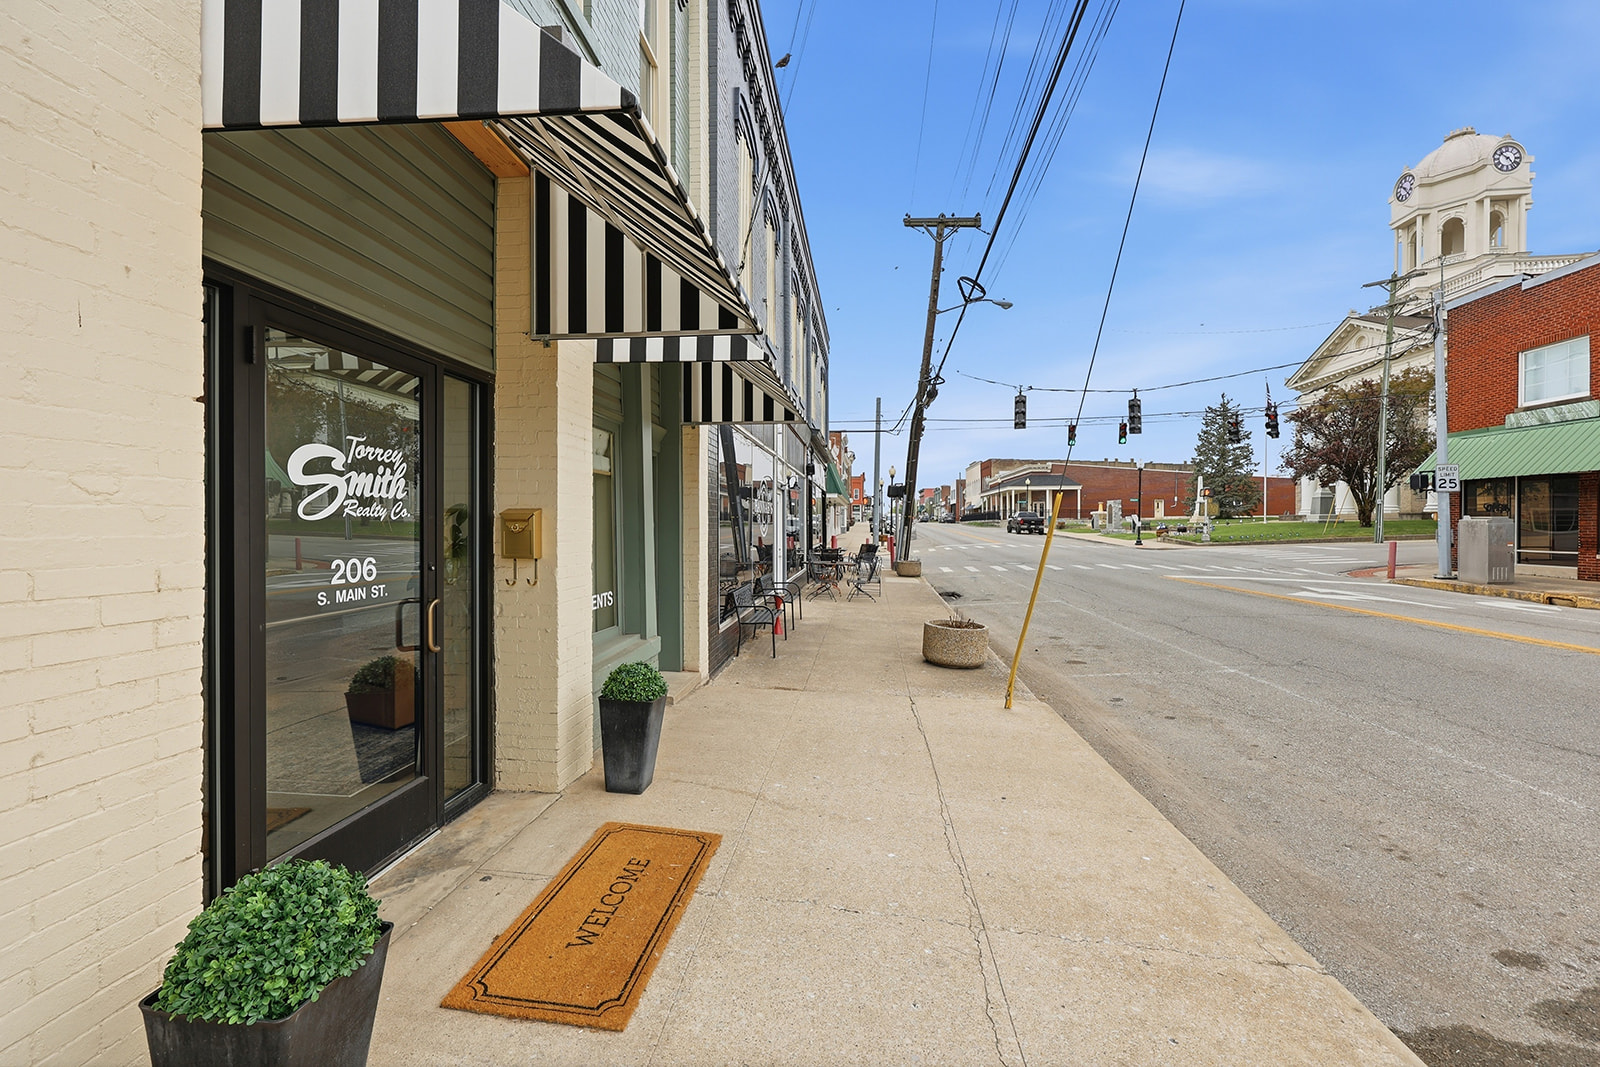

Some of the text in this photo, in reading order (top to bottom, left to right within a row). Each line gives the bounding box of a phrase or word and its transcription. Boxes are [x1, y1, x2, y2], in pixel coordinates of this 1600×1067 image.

[345, 435, 404, 470] Torrey
[287, 443, 407, 521] Smith
[1438, 478, 1457, 489] 25
[343, 499, 411, 521] Realty Co.
[330, 557, 377, 585] 206
[317, 584, 389, 606] S. MAIN ST.
[565, 857, 651, 949] WELCOME
